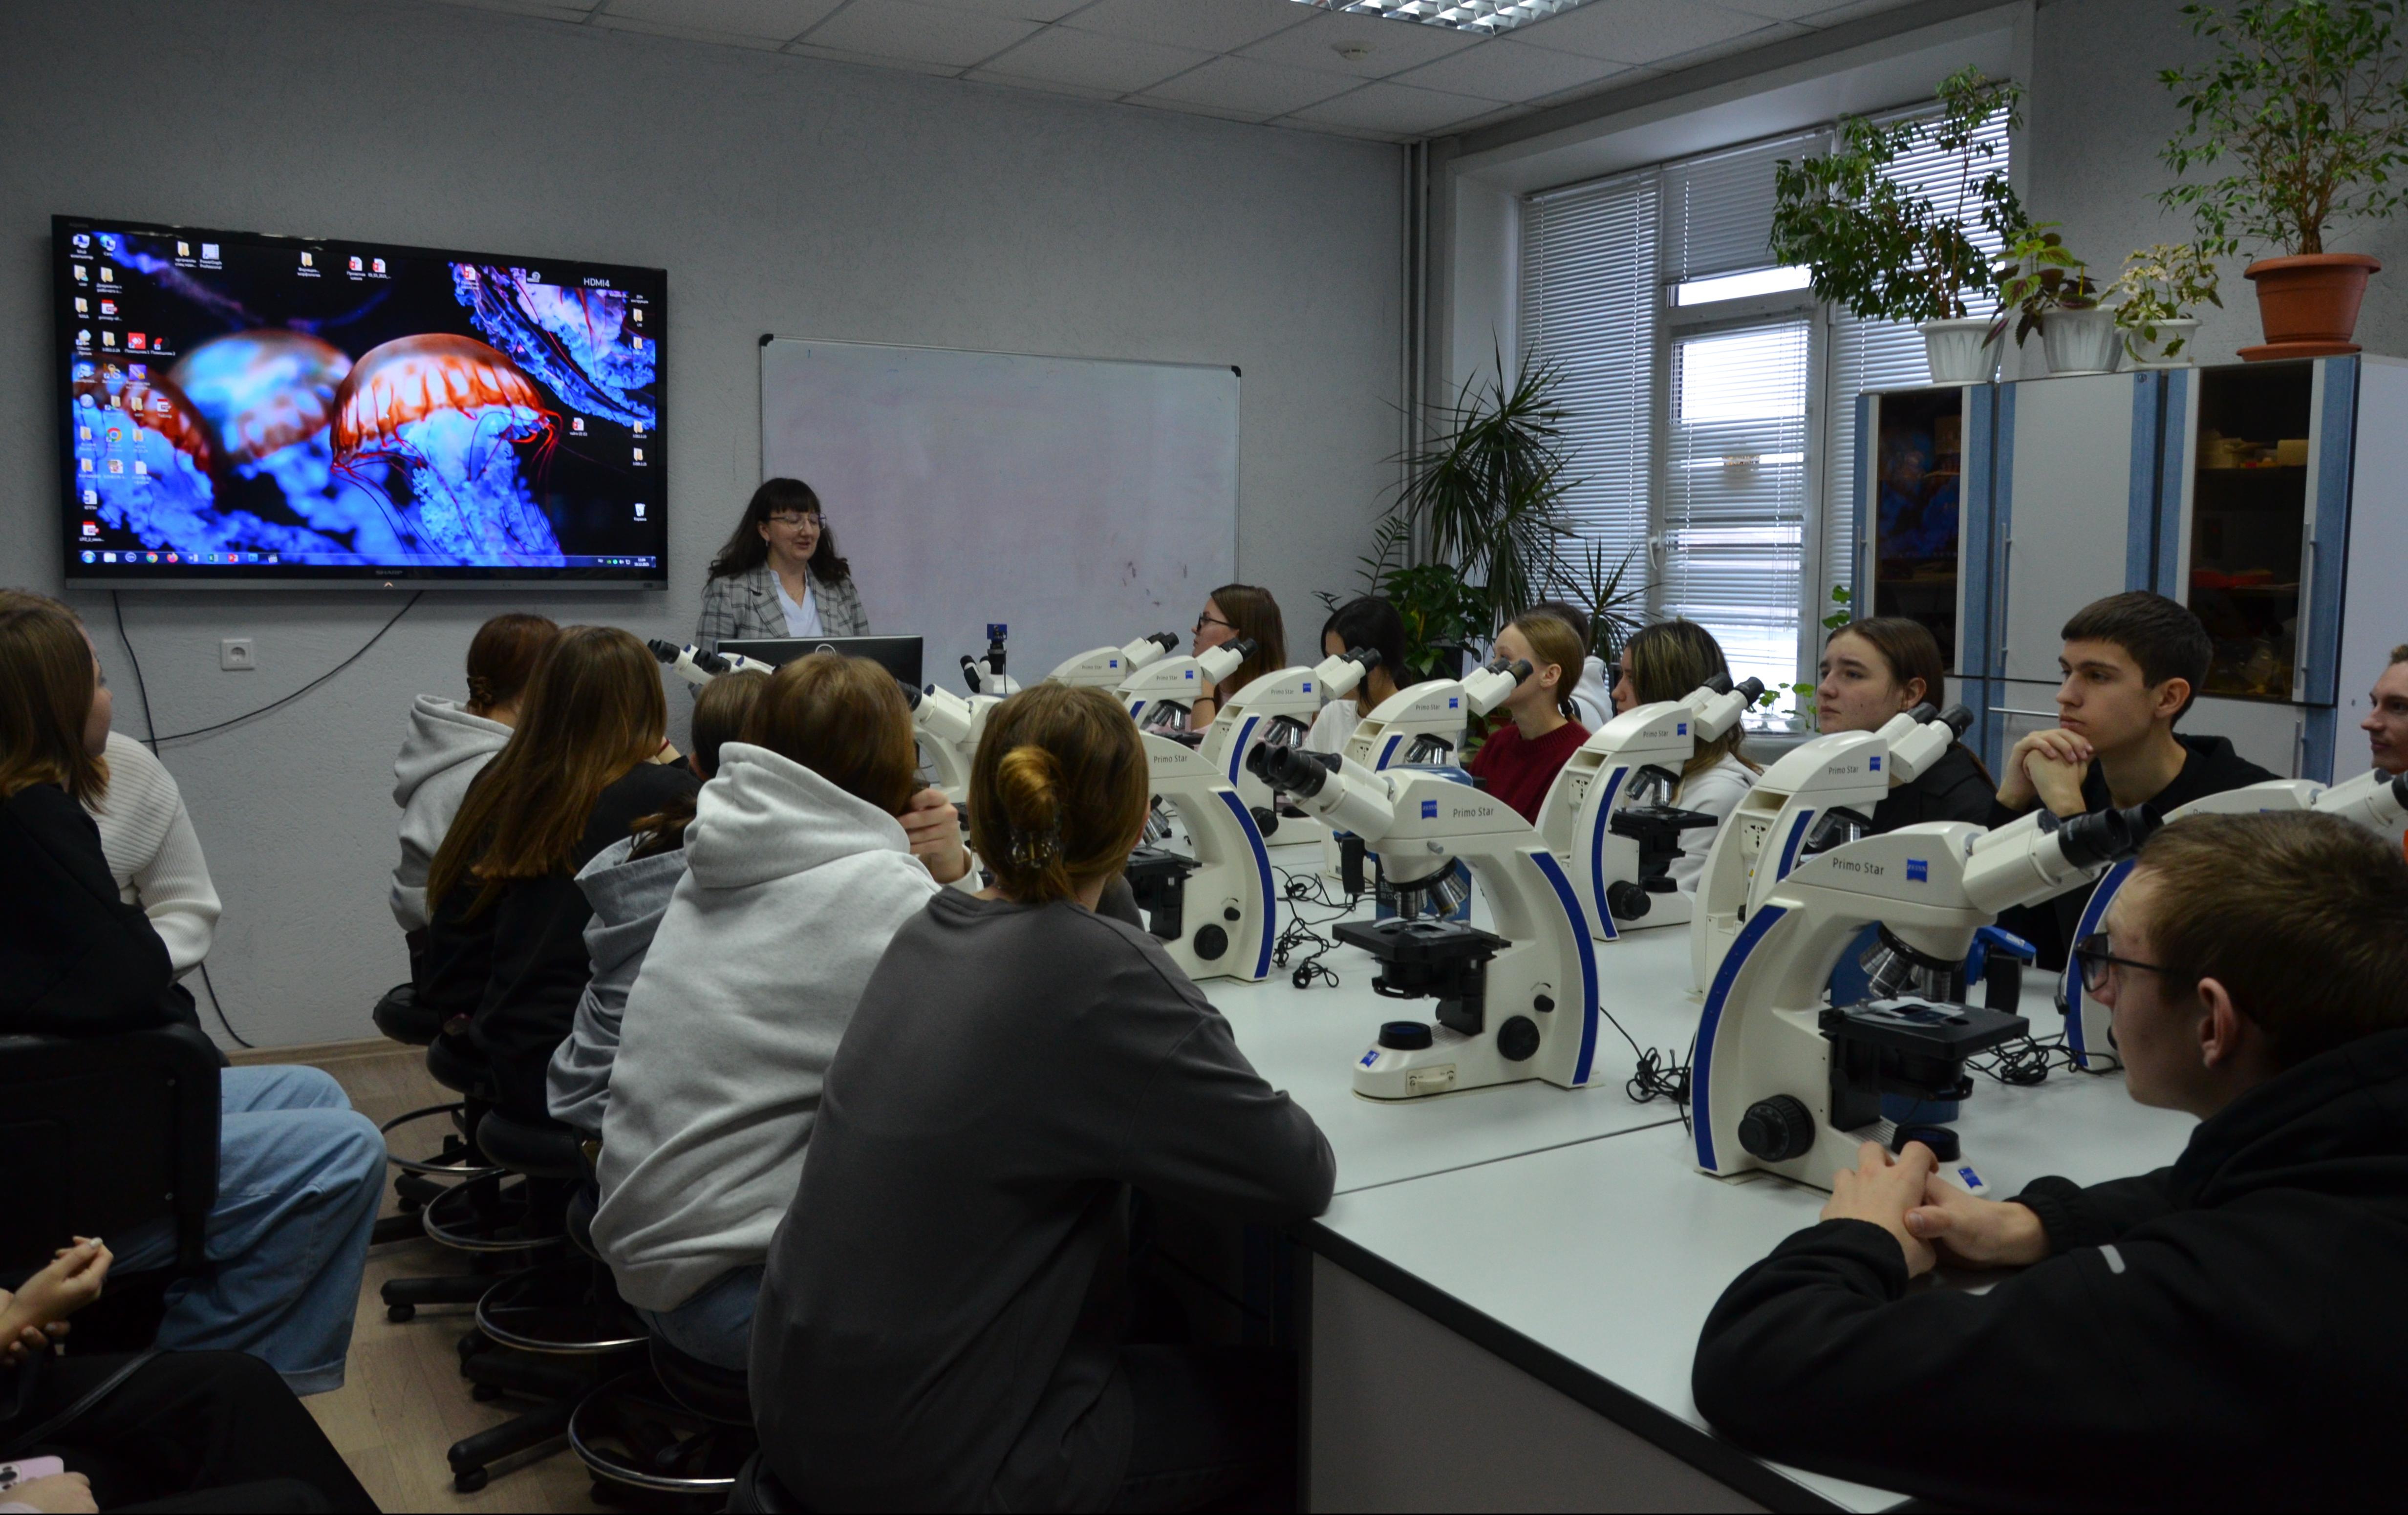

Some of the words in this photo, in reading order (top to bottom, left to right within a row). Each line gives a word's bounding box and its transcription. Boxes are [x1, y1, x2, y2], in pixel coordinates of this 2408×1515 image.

[583, 277, 610, 287] HDMI4
[1453, 808, 1476, 817] Primo
[1477, 807, 1493, 816] Star
[1833, 857, 1861, 872] Primo
[1864, 862, 1884, 875] Star
